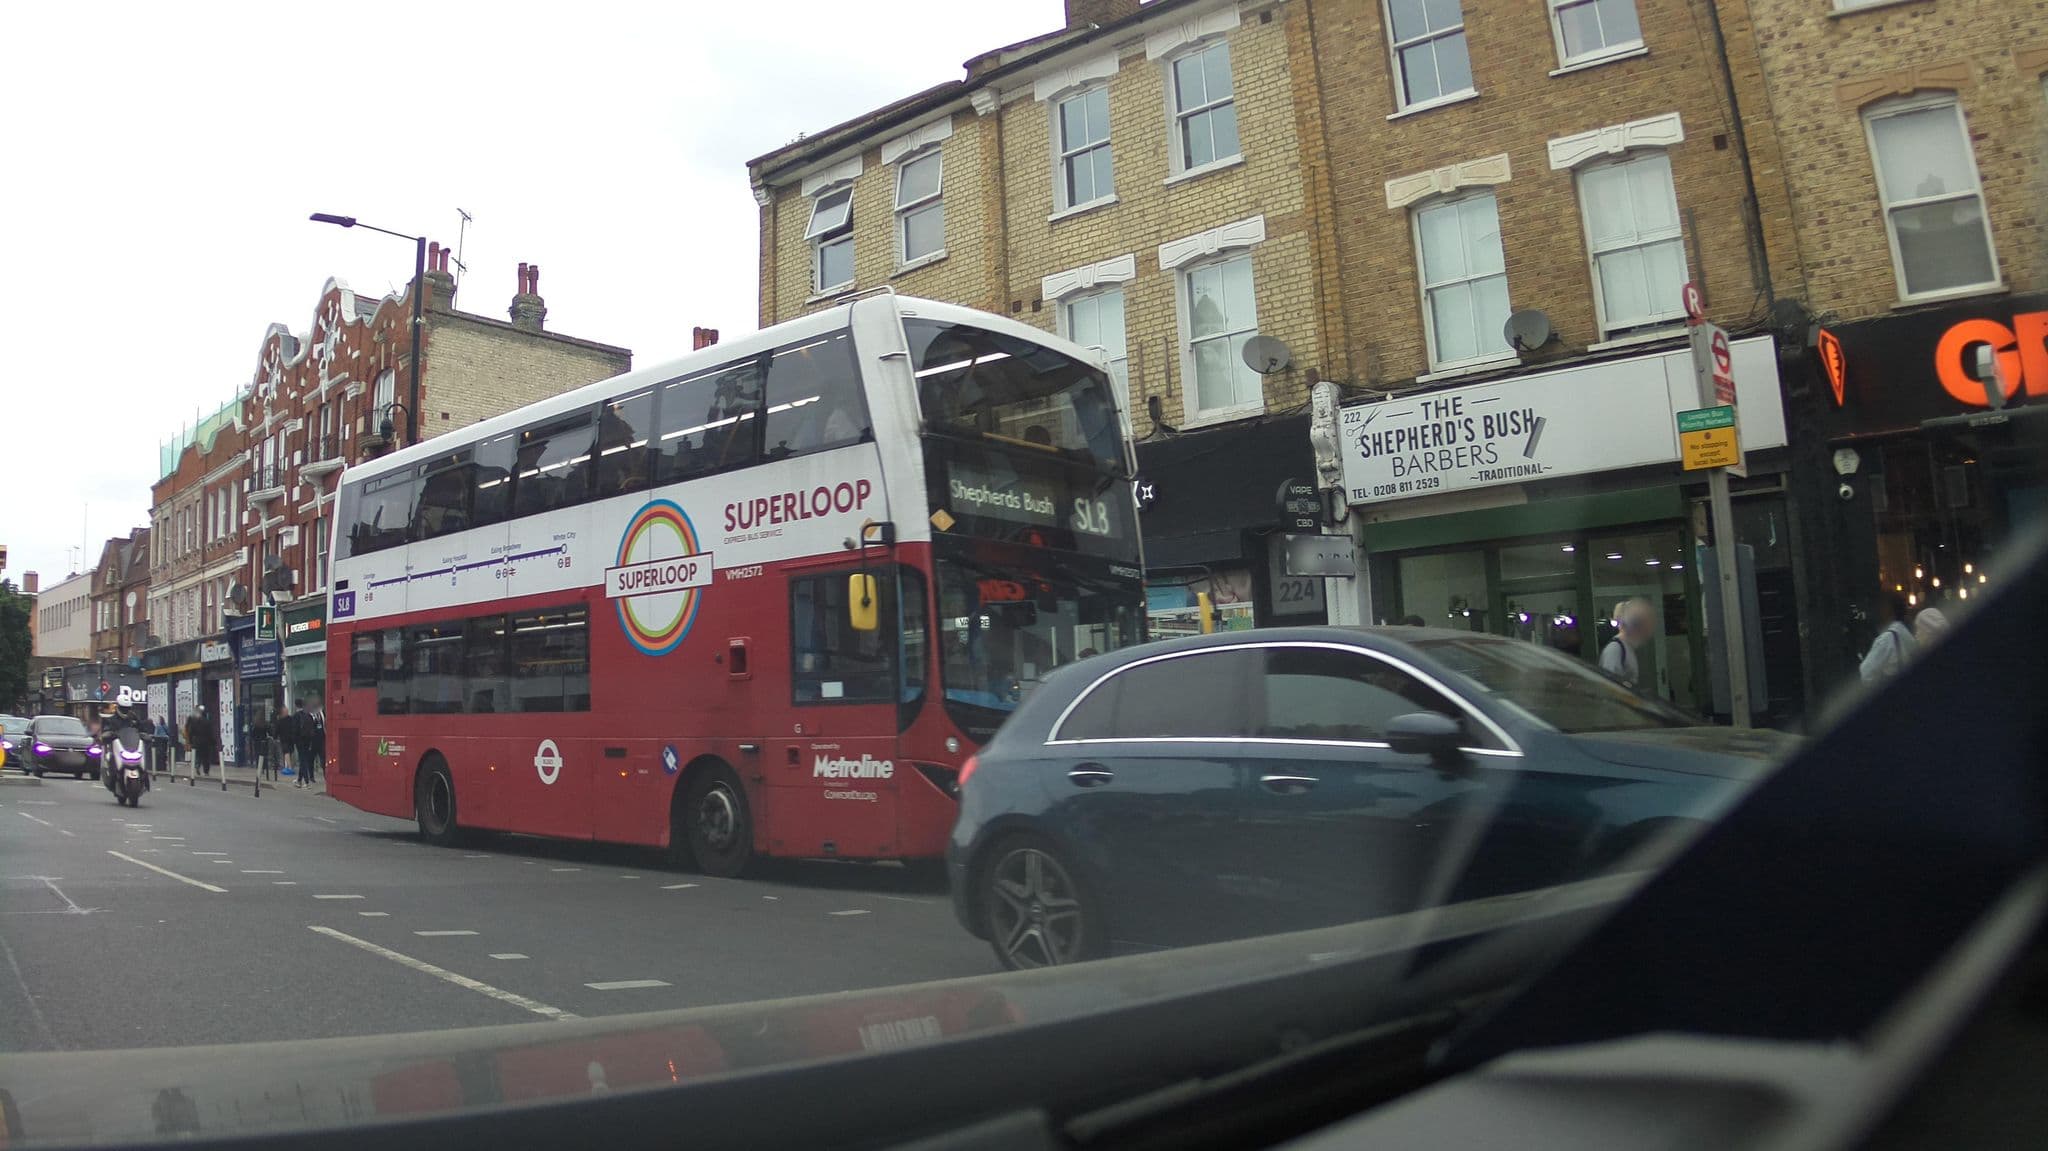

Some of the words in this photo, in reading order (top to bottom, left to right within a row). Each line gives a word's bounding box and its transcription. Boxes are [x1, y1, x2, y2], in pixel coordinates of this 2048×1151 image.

[1688, 287, 1702, 315] R
[1344, 412, 1361, 424] 222
[1421, 396, 1463, 421] THE
[1360, 418, 1475, 458] SHEPHERD'S
[1483, 408, 1534, 439] BUSH
[1392, 443, 1498, 477] BARBERS
[950, 479, 1021, 508] Shepherds
[1023, 492, 1055, 515] Bush
[1290, 486, 1312, 495] VAPE
[1374, 483, 1397, 496] 0208
[1400, 482, 1413, 493] 811
[1416, 477, 1440, 490] 2529
[724, 479, 871, 532] SUPERLOOP
[1074, 497, 1109, 535] SL8
[1296, 519, 1314, 527] CBD
[567, 532, 576, 540] City
[748, 532, 759, 541] BUS
[759, 529, 783, 539] SERVICE
[619, 563, 697, 590] SUPERLOOP
[725, 565, 763, 580] VMH2572
[1280, 579, 1314, 601] 224
[338, 597, 350, 611] SL8
[813, 753, 894, 778] Metroline
